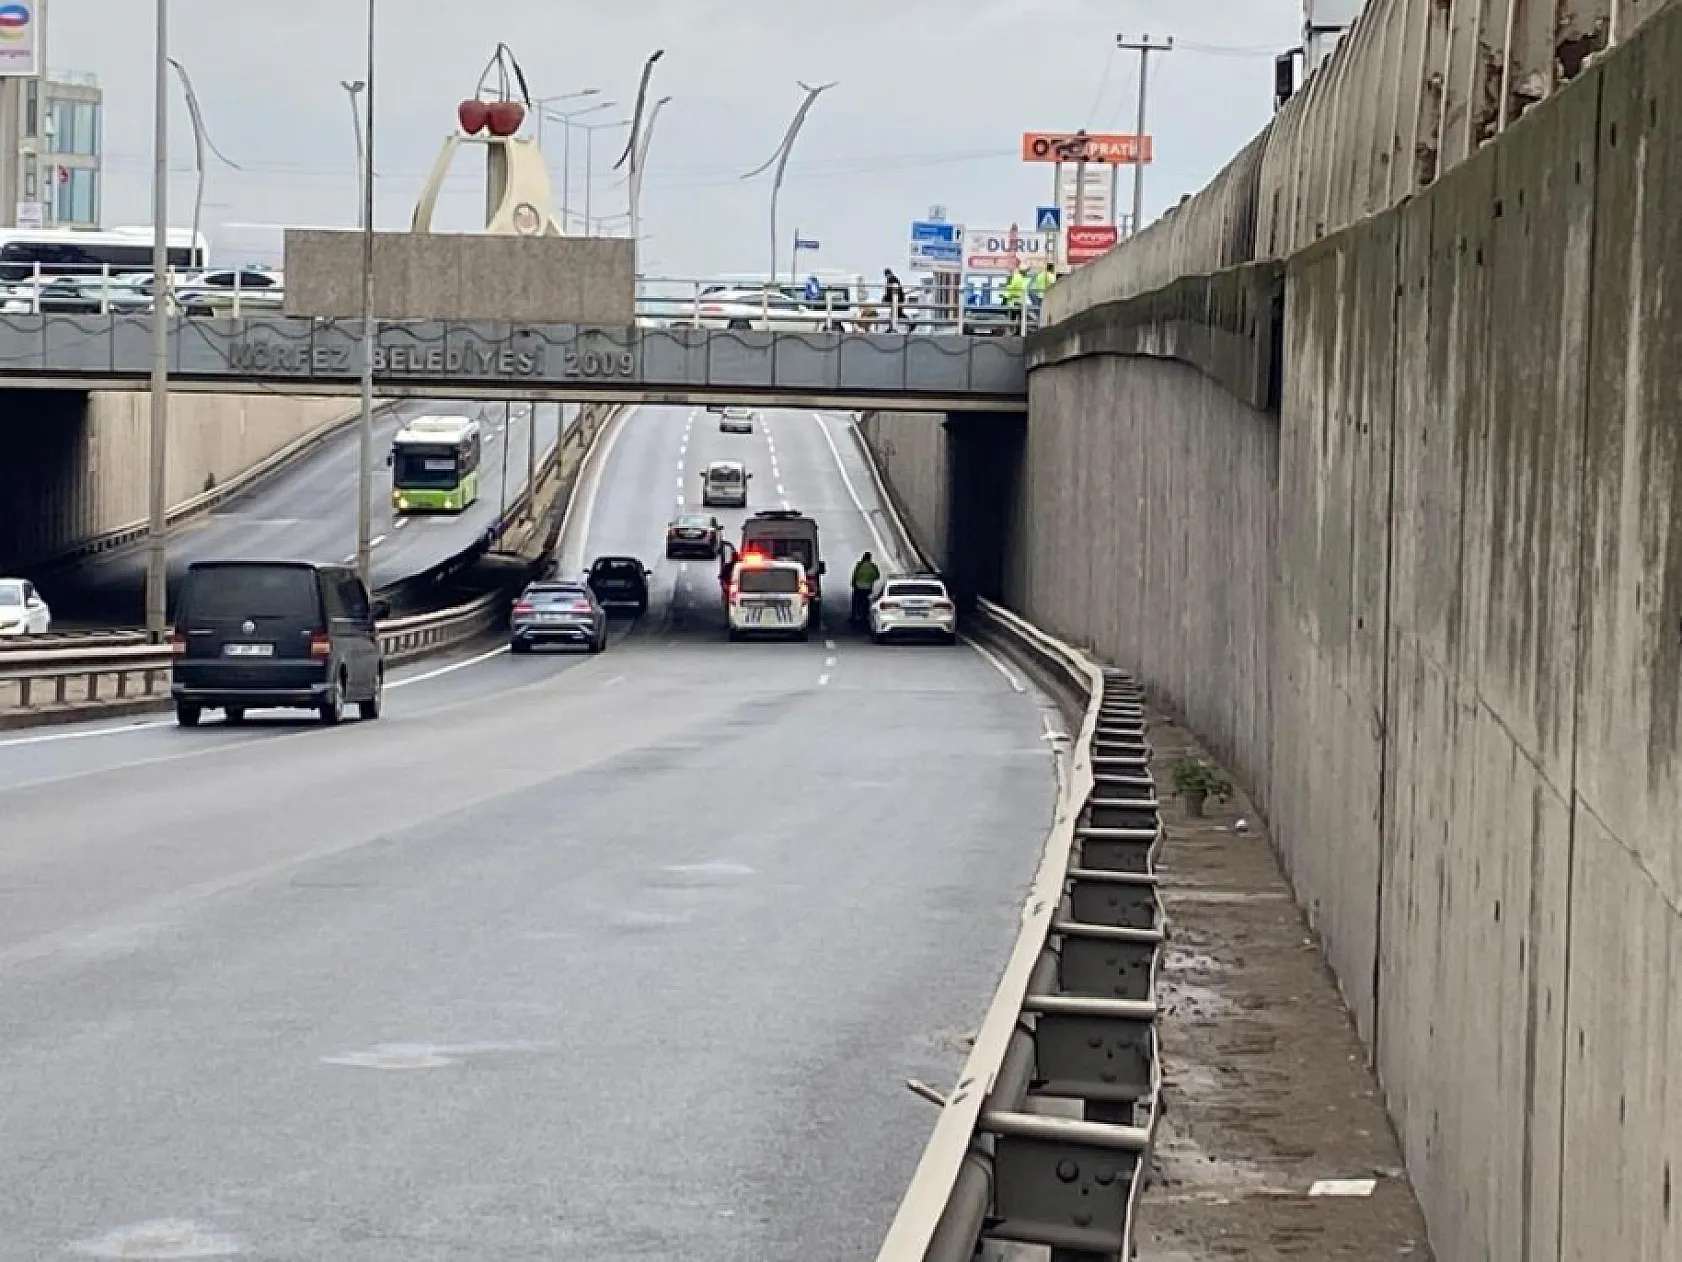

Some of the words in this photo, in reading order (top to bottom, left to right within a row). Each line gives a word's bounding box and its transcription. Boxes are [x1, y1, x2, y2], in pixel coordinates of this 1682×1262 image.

[231, 342, 350, 371] KÖRFEZ
[374, 342, 545, 376] BELEDİYESİ
[564, 352, 635, 377] 2009
